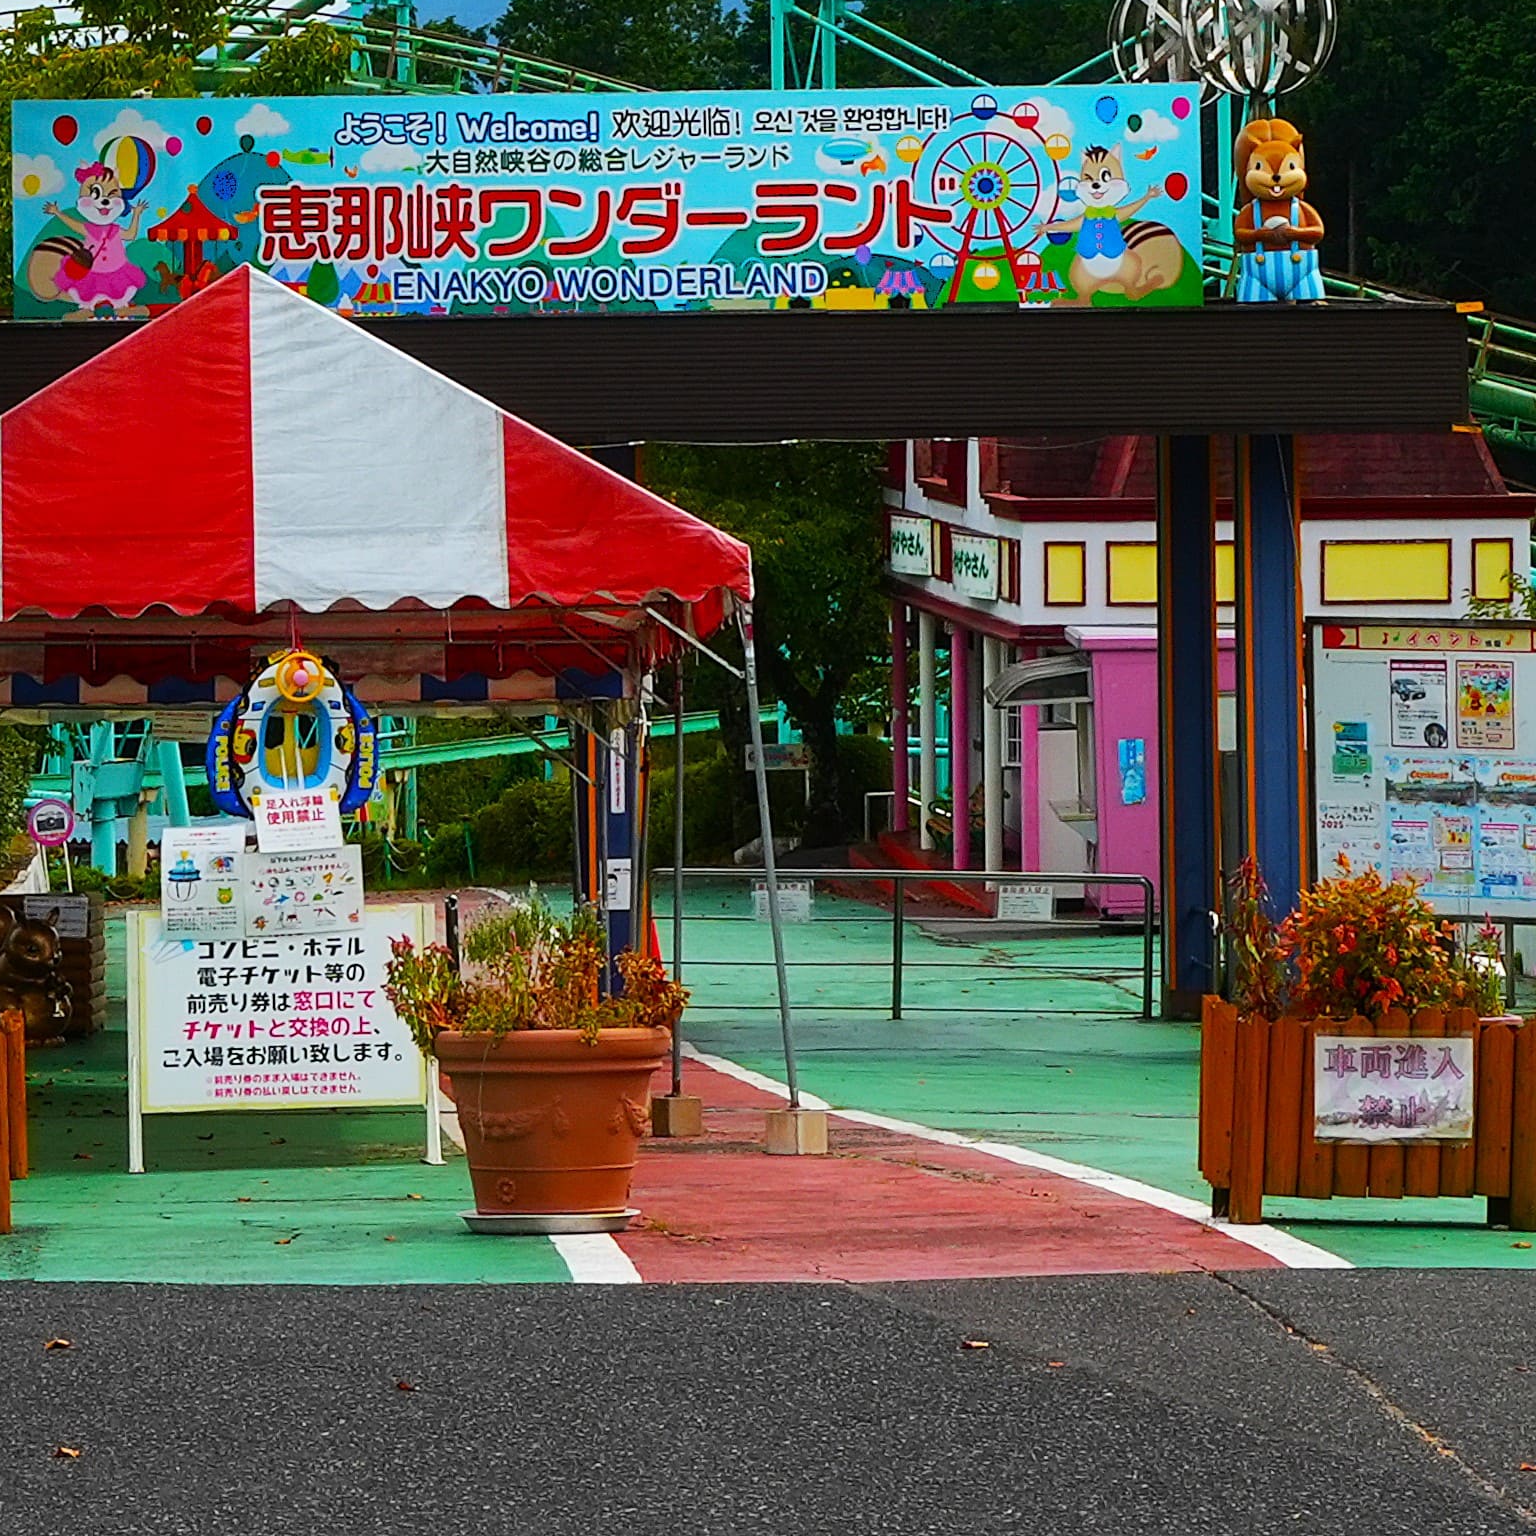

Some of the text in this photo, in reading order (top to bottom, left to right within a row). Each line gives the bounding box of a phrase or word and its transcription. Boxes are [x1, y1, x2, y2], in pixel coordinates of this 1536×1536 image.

[335, 107, 948, 144] ようこそ! Welcome! 欢迎光临! 오신 것을 환영합니다!
[426, 145, 790, 175] 大自然峡谷の総合レジャーランド
[259, 178, 958, 262] 恵那峡ワンダーランド
[393, 265, 828, 302] ENAKYO WONDERLAND
[216, 735, 231, 792] POLICE
[358, 732, 374, 789] POLICE
[266, 808, 326, 825] 使用禁止
[197, 937, 366, 960] コンビニ・ホテル
[197, 963, 366, 988] 電子チケット等の
[186, 990, 376, 1014] 前売り券は窓口にて
[182, 1016, 382, 1041] チケットと交換の上、
[162, 1042, 405, 1069] ご入場をお願い致します。
[1323, 1043, 1465, 1080] 車両進入
